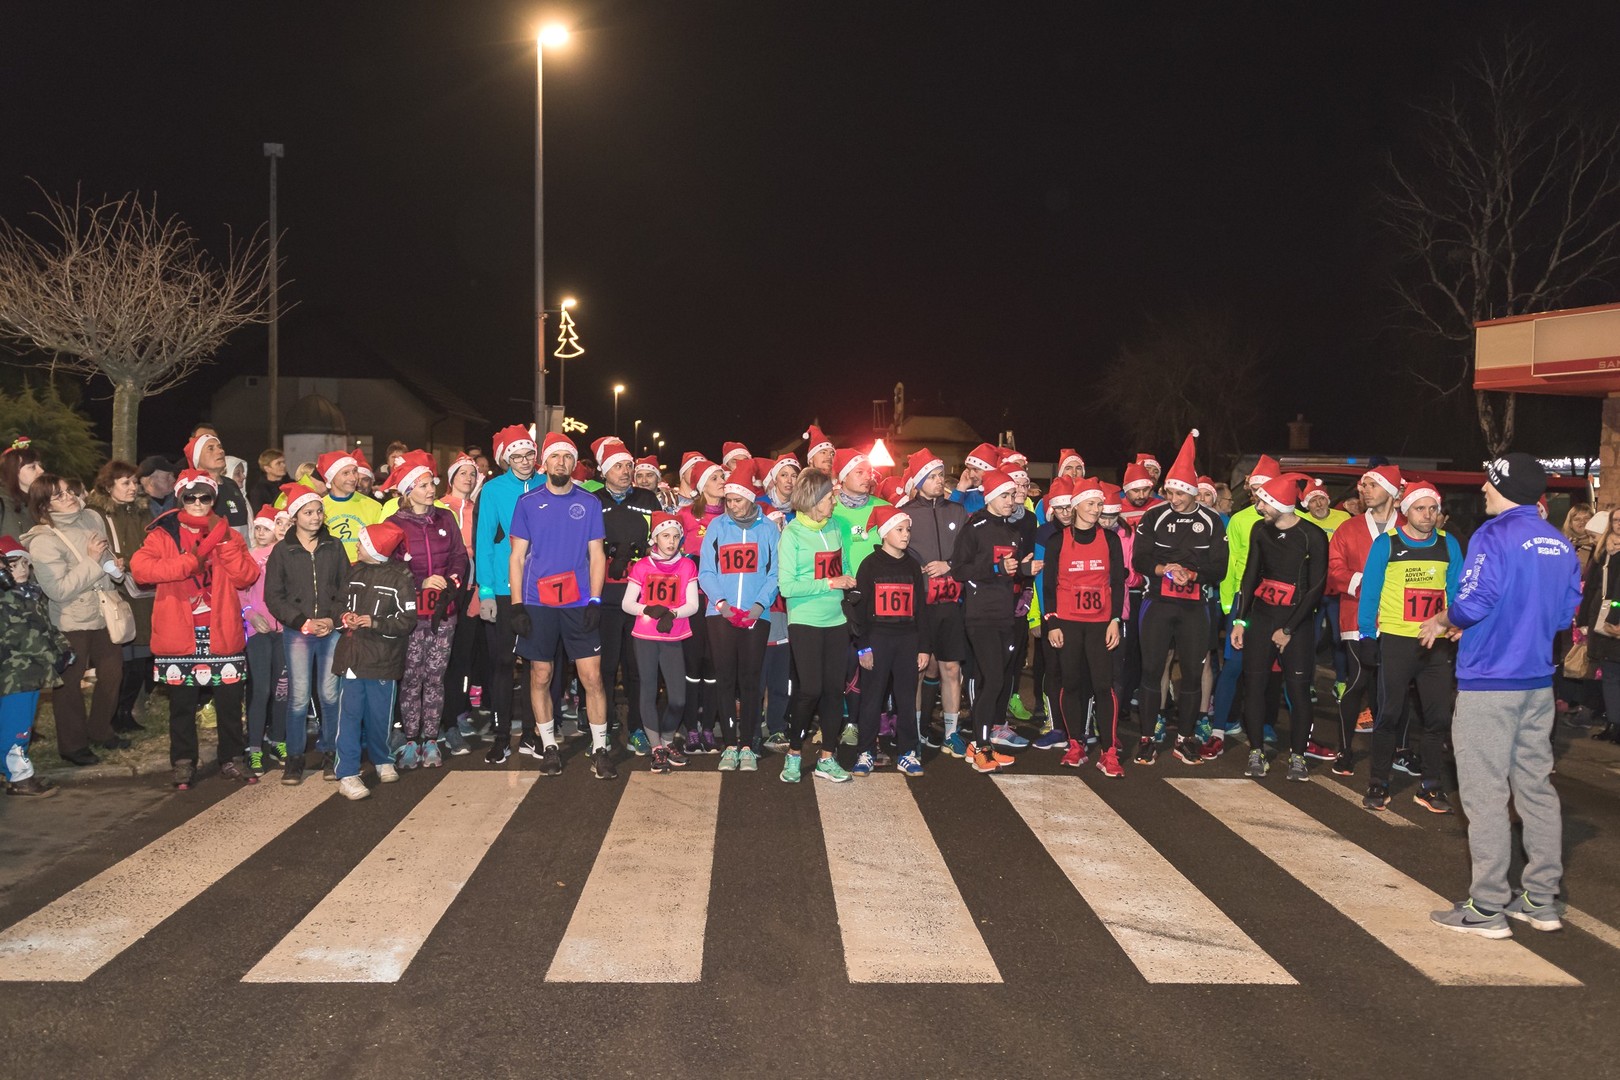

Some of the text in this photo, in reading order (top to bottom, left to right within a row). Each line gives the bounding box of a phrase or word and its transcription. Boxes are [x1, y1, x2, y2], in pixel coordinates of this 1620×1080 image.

[1167, 523, 1176, 533] 11
[1522, 540, 1533, 550] TK
[722, 550, 755, 569] 162
[552, 582, 563, 602] 7
[647, 581, 676, 602] 161
[879, 591, 911, 611] 167
[1075, 591, 1102, 610] 138
[1260, 586, 1287, 605] 137
